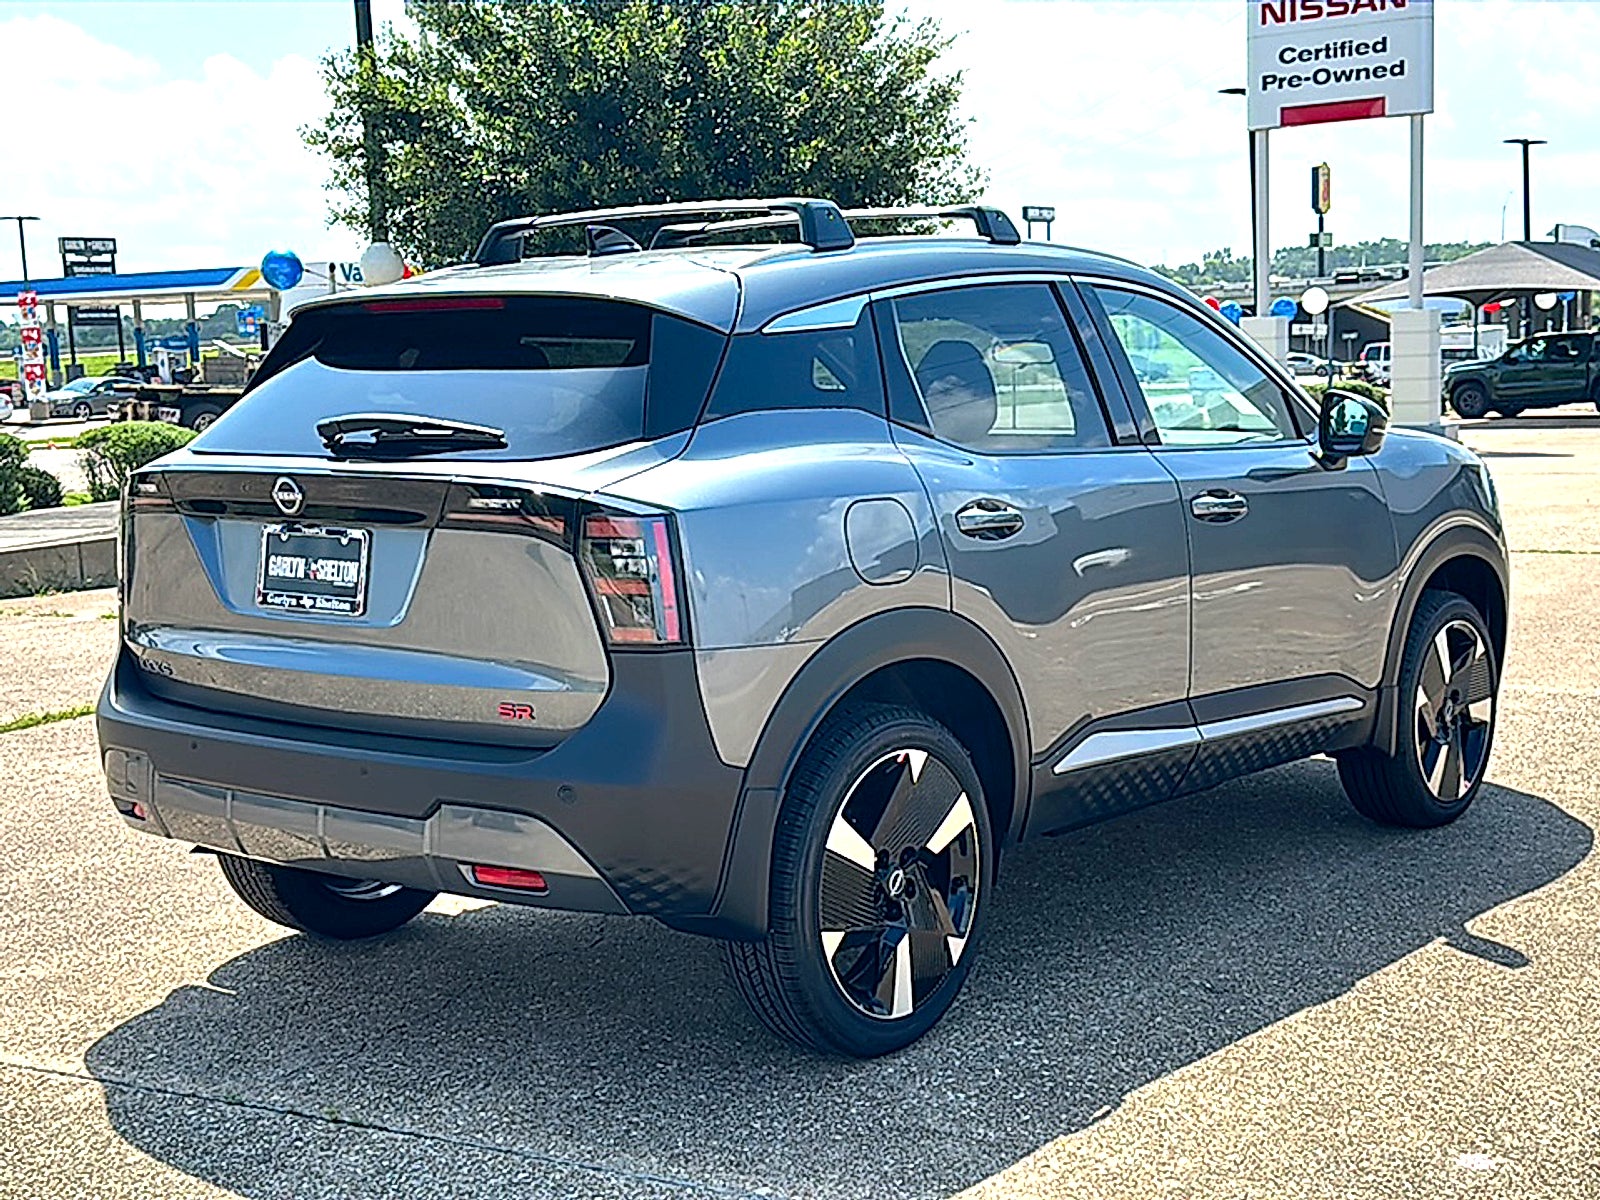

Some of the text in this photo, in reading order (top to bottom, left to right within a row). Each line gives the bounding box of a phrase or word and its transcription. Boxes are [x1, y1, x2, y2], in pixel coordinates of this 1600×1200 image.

[1278, 36, 1388, 64] Certified
[1261, 59, 1405, 91] Pre-Owned
[316, 558, 360, 583] SHELTON
[497, 701, 536, 721] SR
